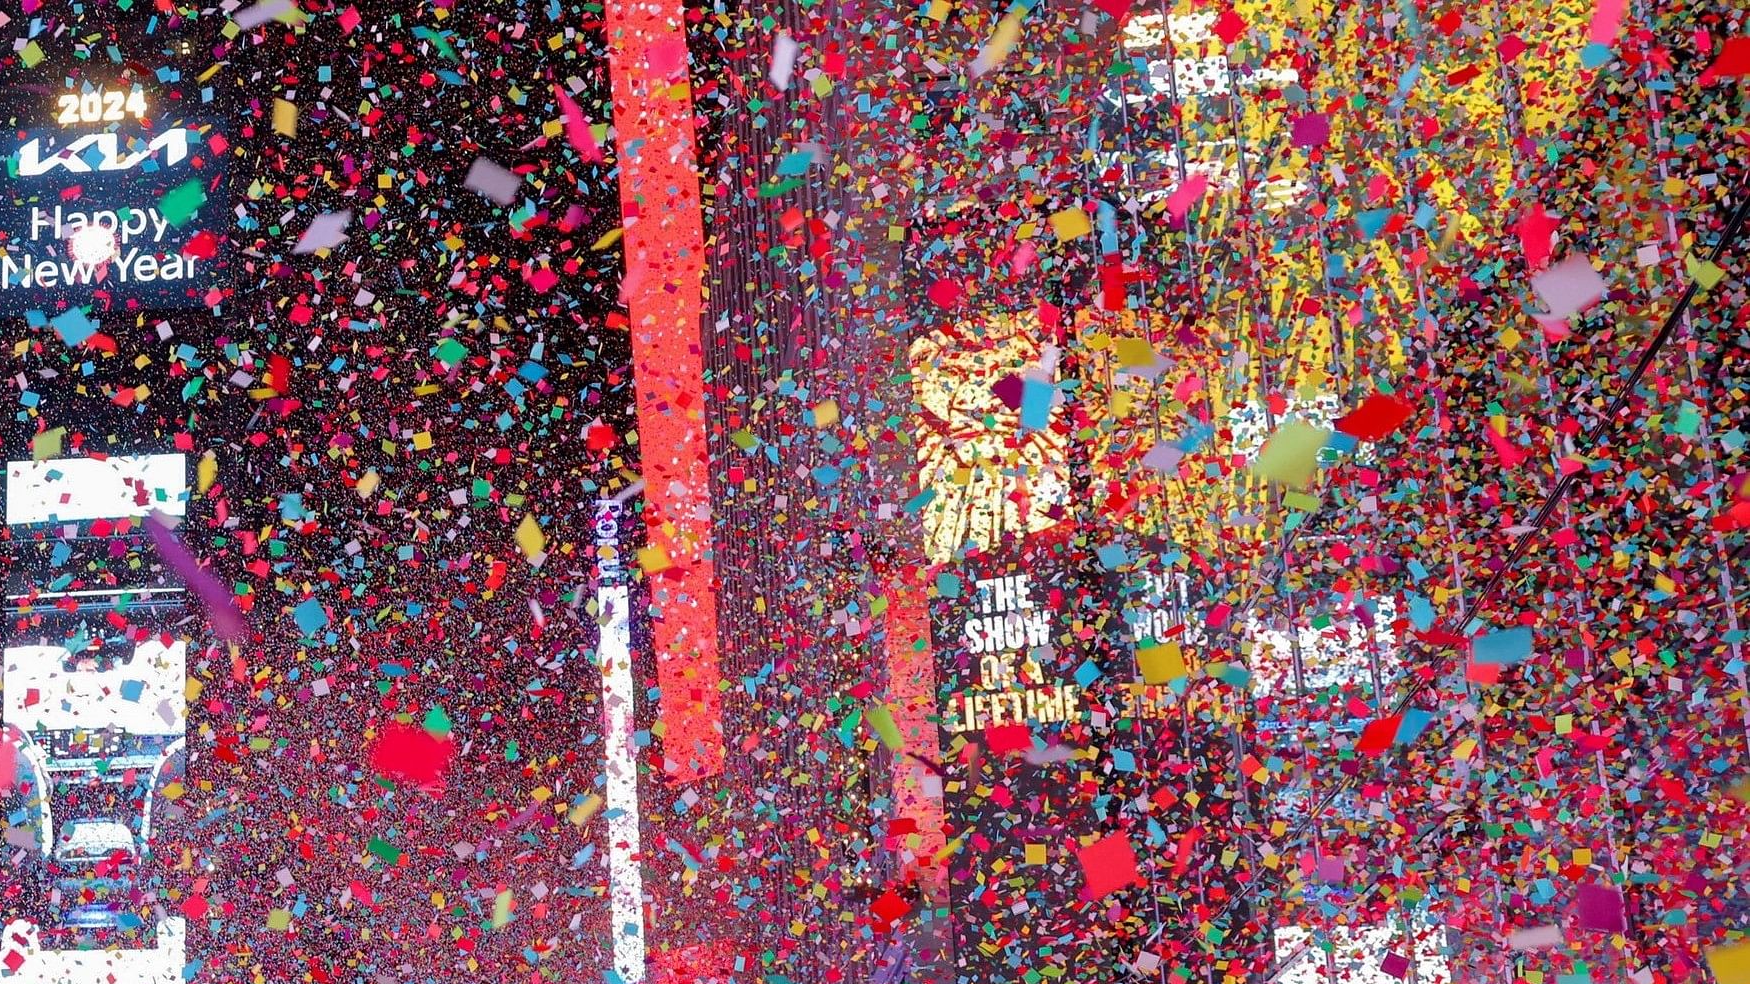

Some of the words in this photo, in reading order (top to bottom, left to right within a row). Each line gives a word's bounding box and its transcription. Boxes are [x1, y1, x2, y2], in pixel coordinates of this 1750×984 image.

[57, 90, 147, 124] 2024
[18, 129, 188, 176] KIA
[2, 254, 93, 289] New
[116, 247, 200, 283] Year
[976, 574, 1034, 613] THE
[965, 610, 1050, 653] SHOW
